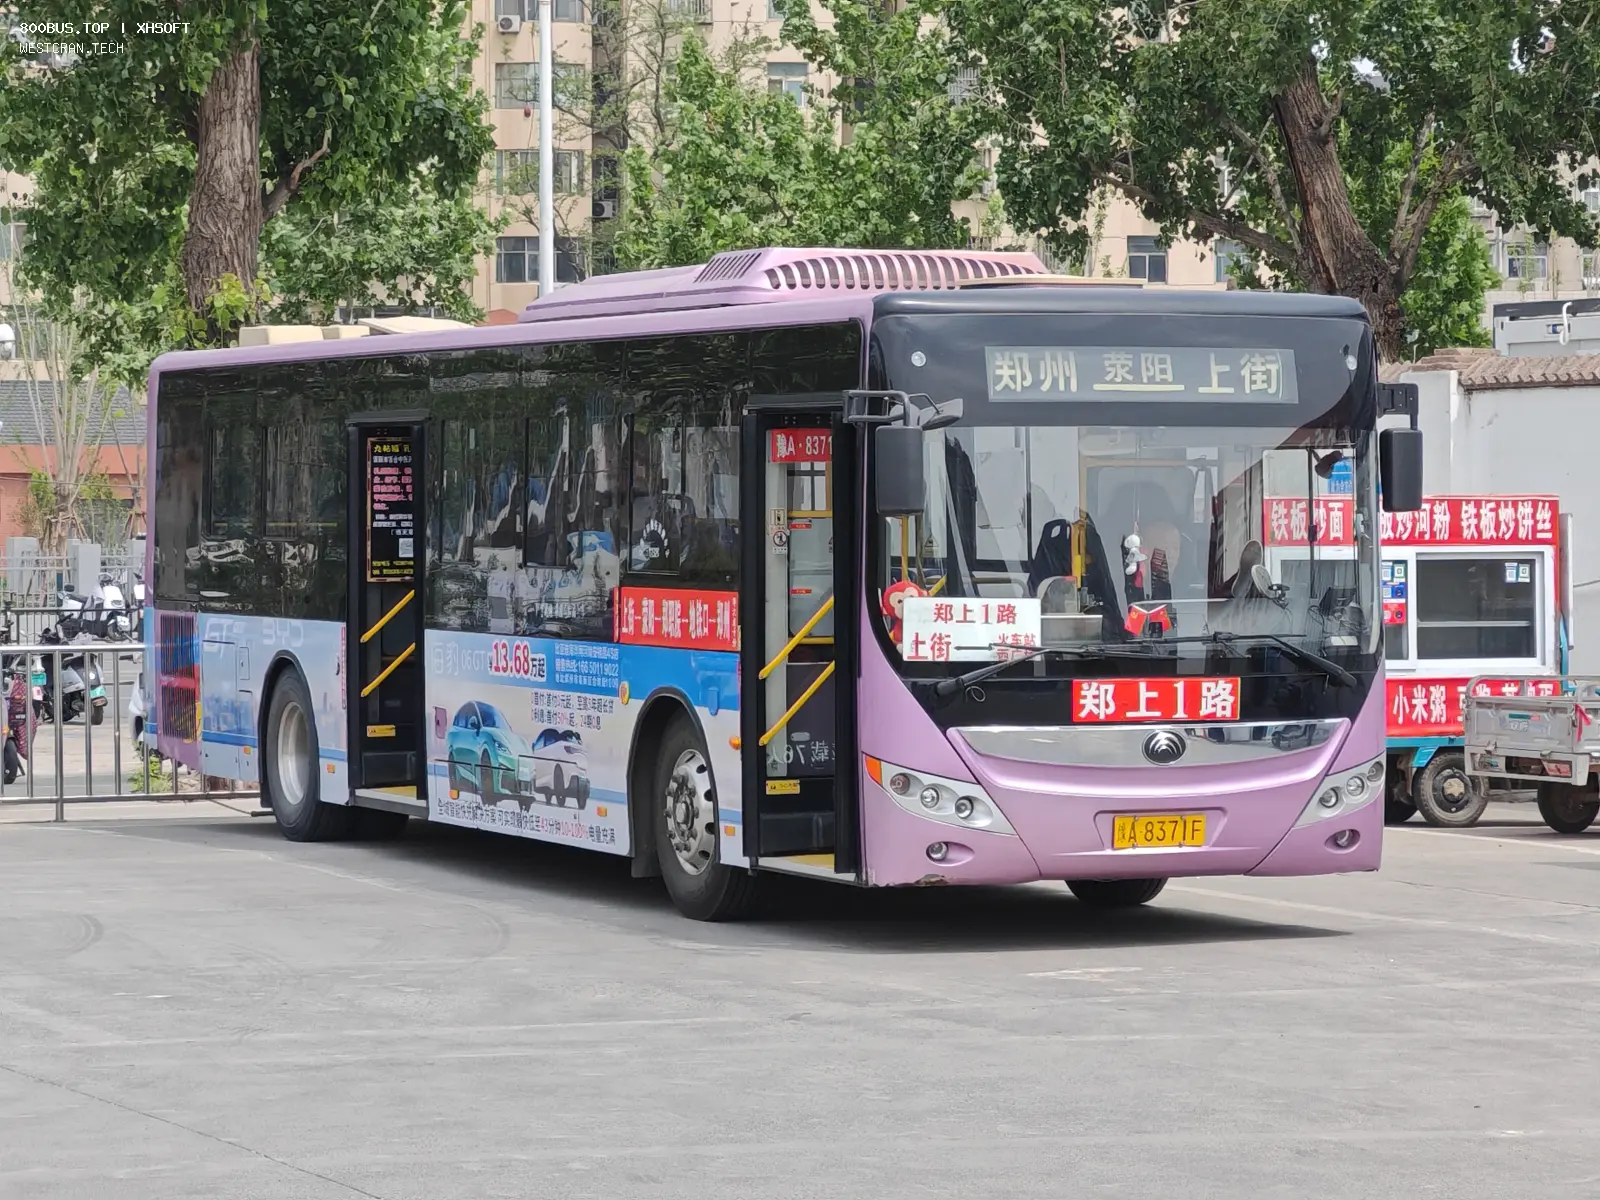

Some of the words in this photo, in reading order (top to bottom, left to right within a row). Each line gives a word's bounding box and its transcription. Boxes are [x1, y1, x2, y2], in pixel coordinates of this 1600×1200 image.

[994, 351, 1078, 393] 郑州
[1103, 350, 1175, 384] 荥阳
[1197, 352, 1280, 394] 上街
[1271, 500, 1344, 541] 铁板炒面
[1461, 500, 1553, 541] 铁板炒饼丝
[933, 603, 1018, 625] 郑上1路
[906, 632, 952, 662] 上街
[1079, 680, 1236, 720] 郑上1路
[1393, 684, 1447, 724] 小米粥
